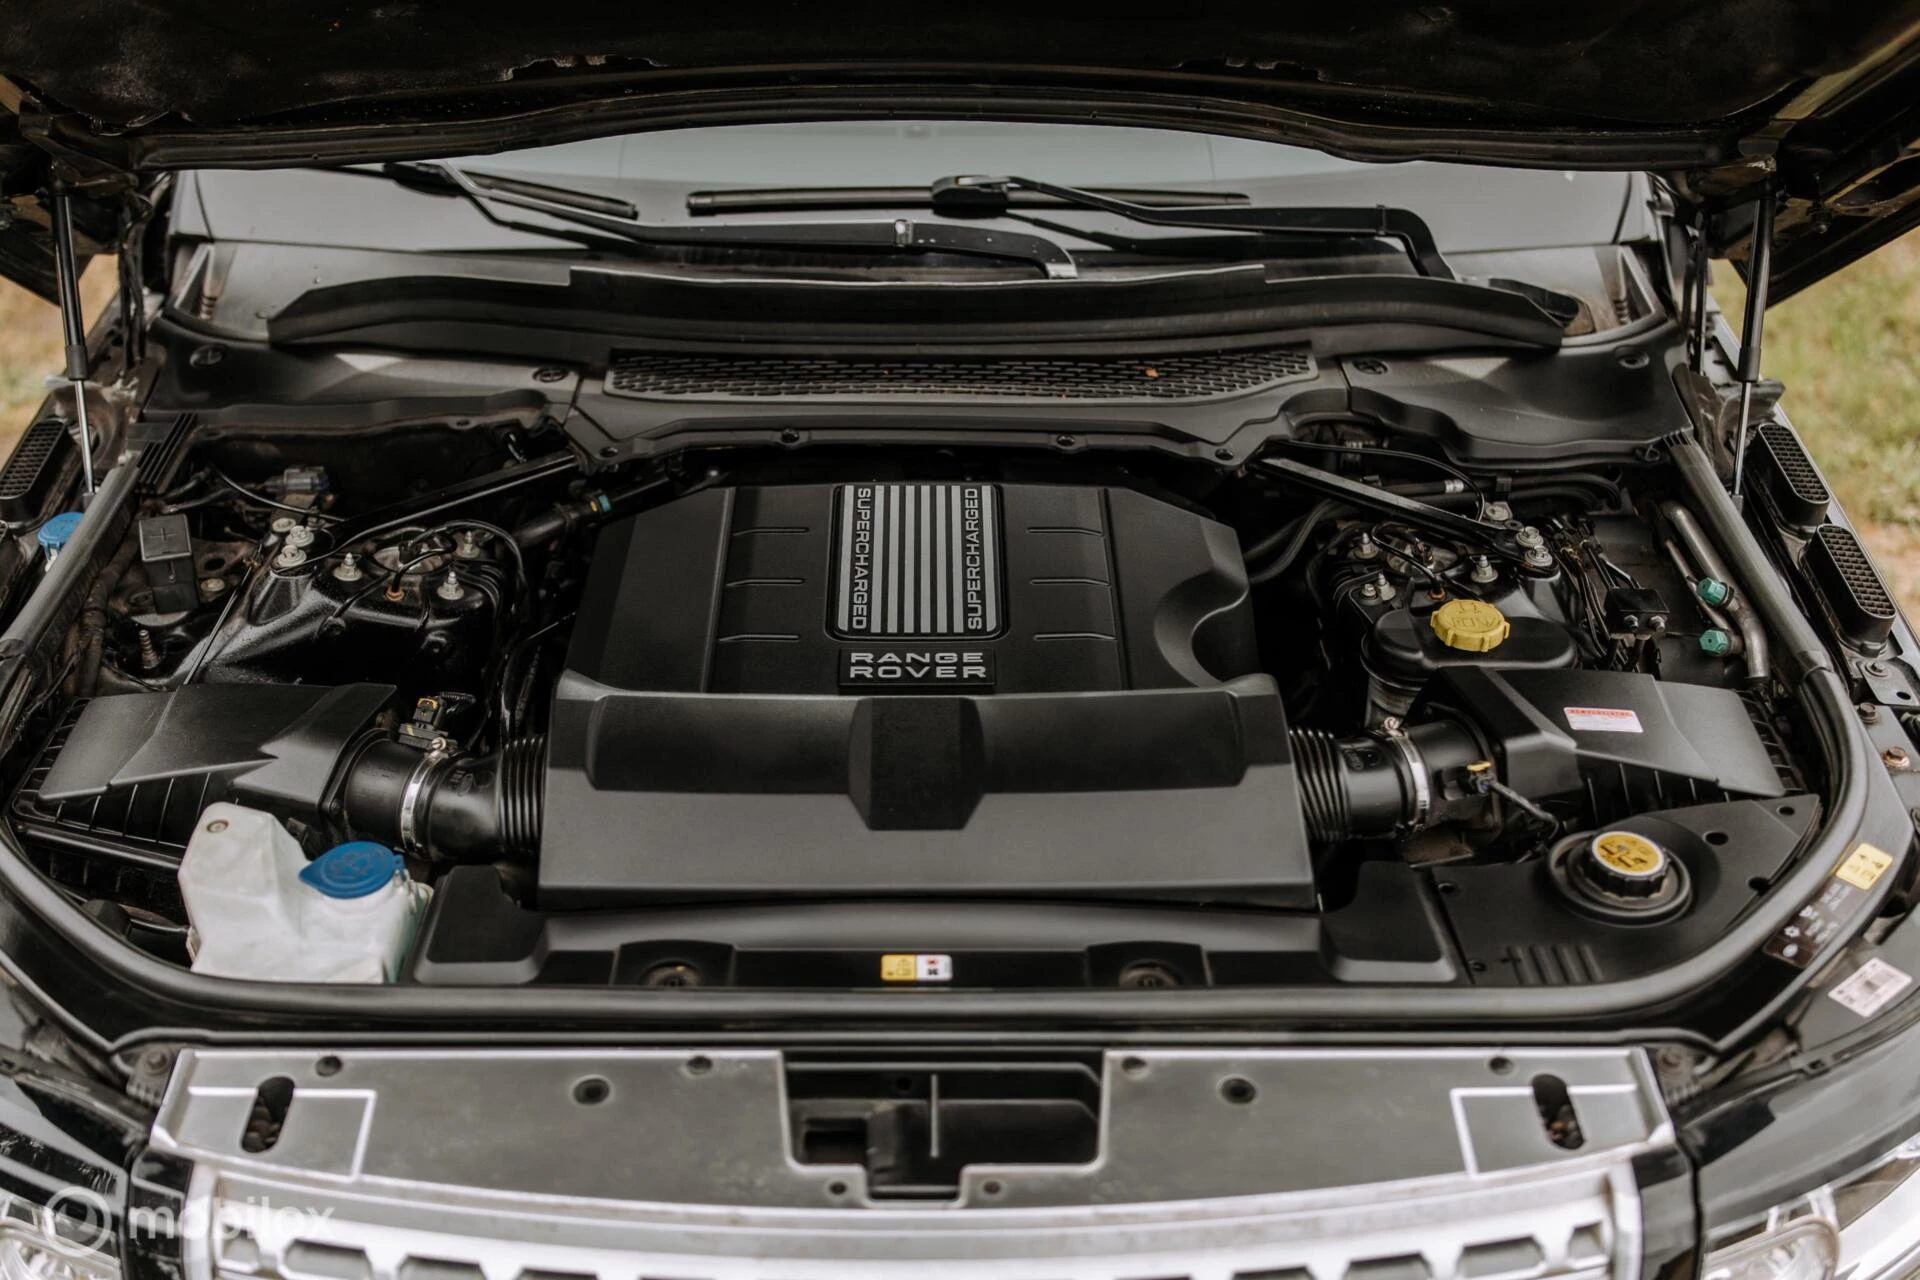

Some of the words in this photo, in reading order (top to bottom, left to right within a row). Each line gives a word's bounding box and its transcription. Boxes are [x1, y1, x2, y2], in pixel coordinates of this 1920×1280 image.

[852, 487, 872, 630] SUPERCHARGED
[965, 487, 983, 631] SUPERCHARGED
[849, 666, 987, 679] ROVER
[850, 652, 984, 664] RANGE
